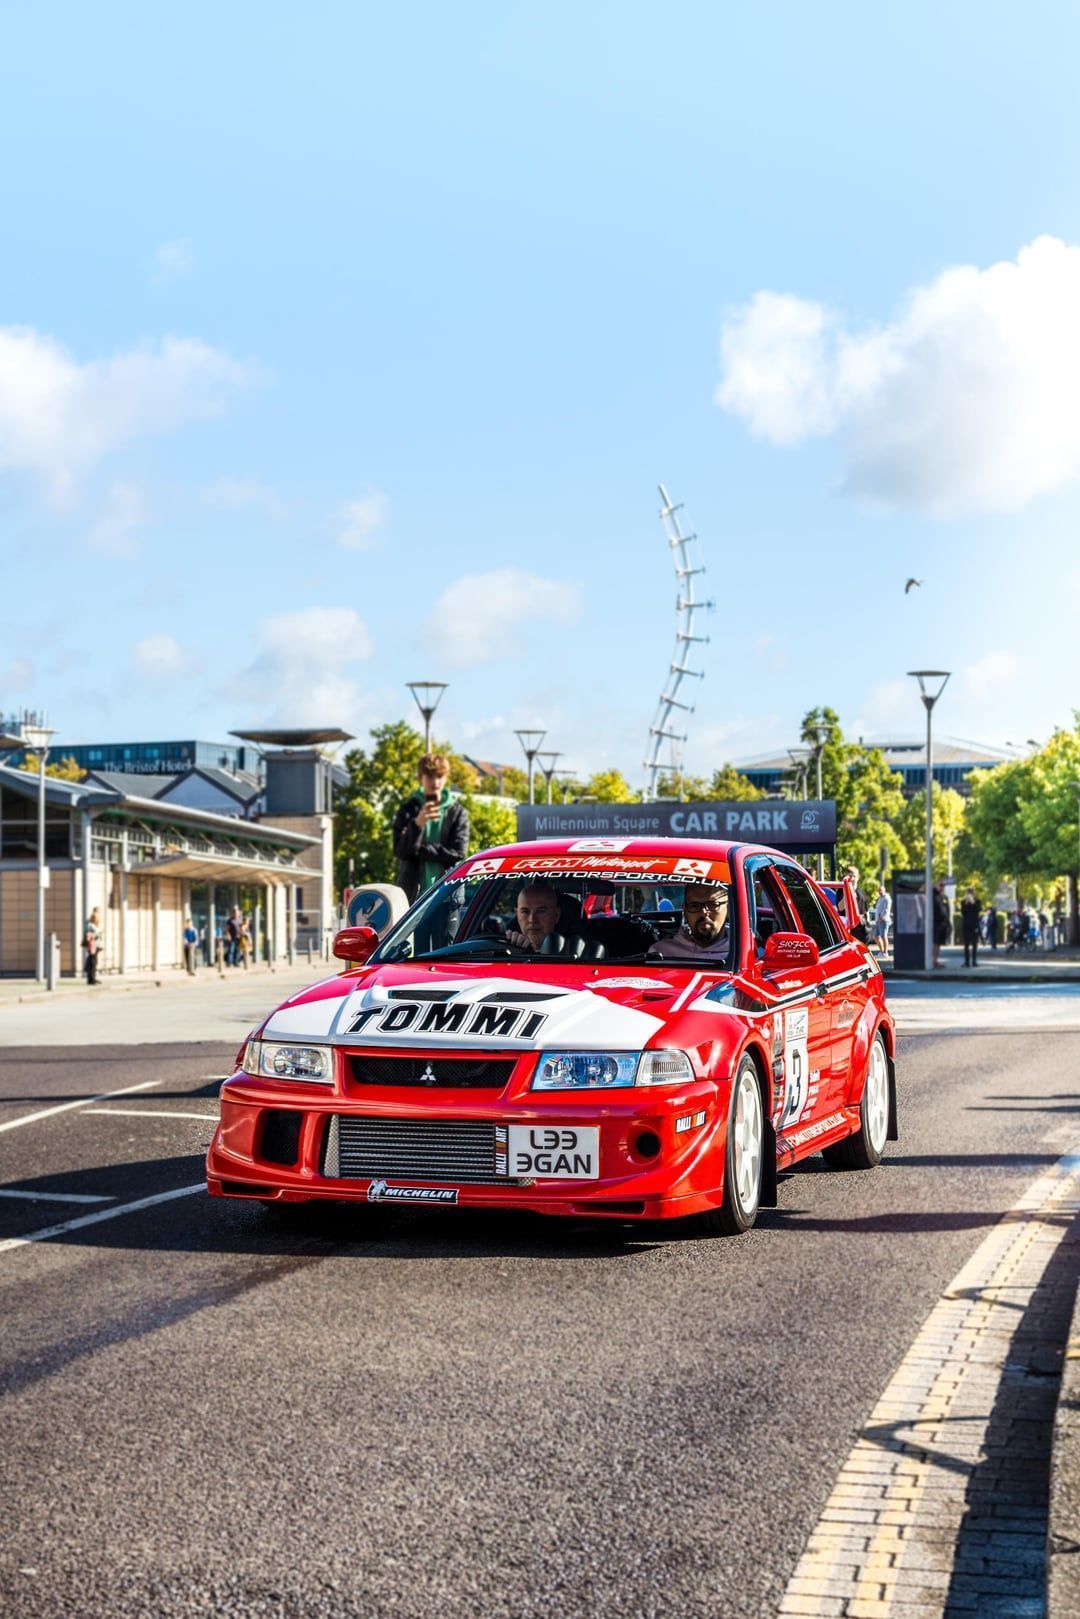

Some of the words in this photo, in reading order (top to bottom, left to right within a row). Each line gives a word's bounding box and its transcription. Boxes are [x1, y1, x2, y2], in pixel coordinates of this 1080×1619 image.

[124, 760, 160, 773] Bristol
[161, 758, 192, 771] Hotel
[535, 816, 609, 831] Millennium
[613, 816, 660, 832] Square
[670, 811, 718, 832] CAR
[726, 810, 788, 831] PARK
[512, 858, 585, 869] FCM
[581, 856, 668, 870] Motorsport
[444, 870, 729, 890] WWW.FCMMOTORSPORT.CO.UK
[344, 1002, 549, 1040] TOMMI
[495, 1126, 508, 1143] ART
[495, 1152, 508, 1175] RALLI
[385, 1188, 454, 1198] MICHELIN
